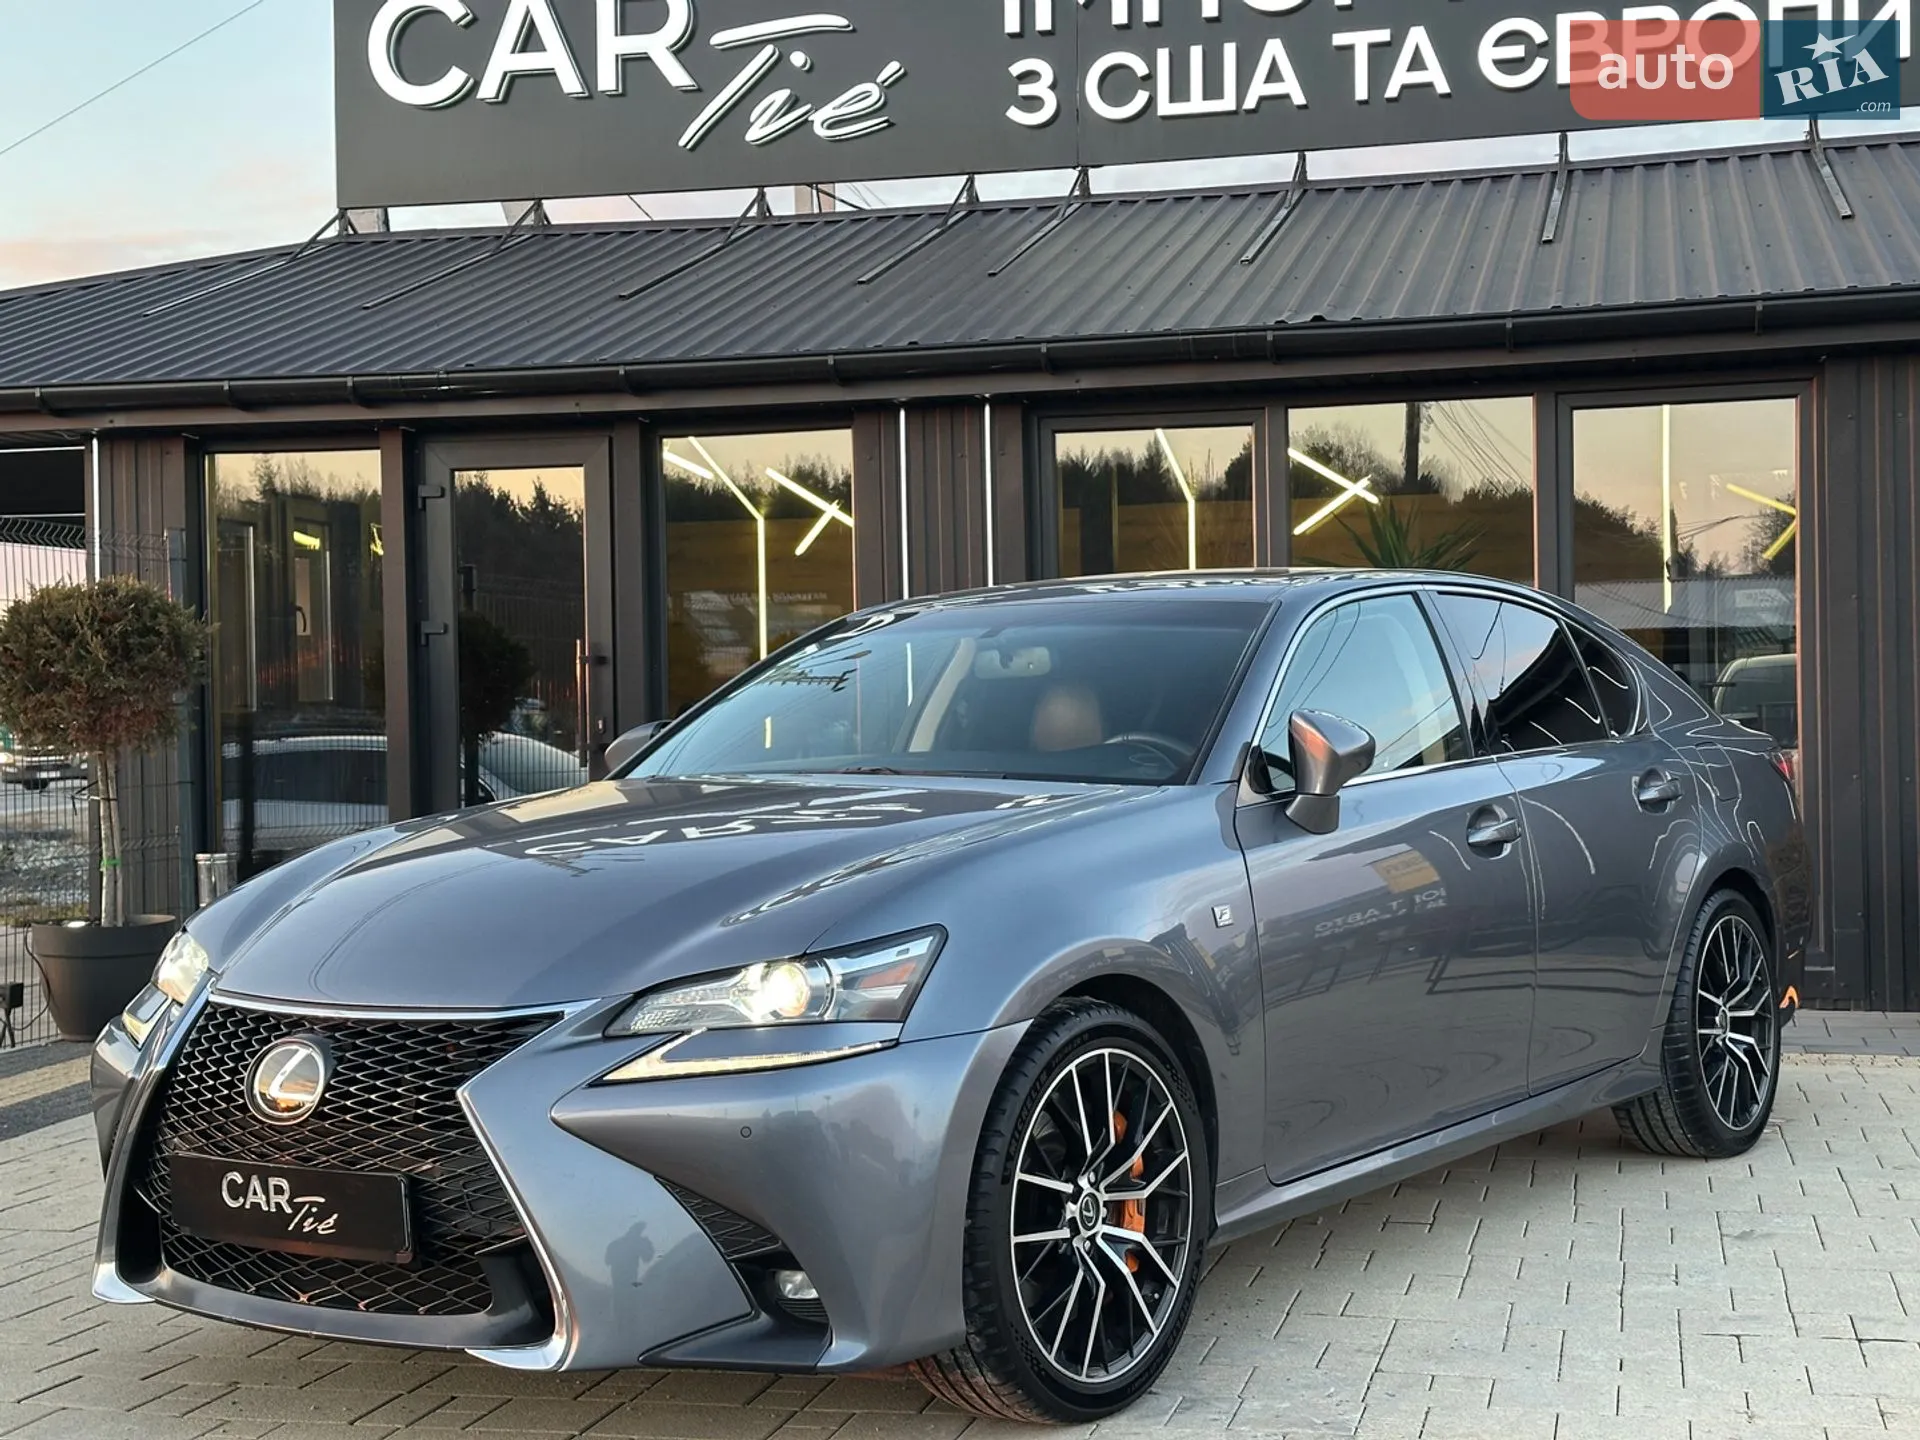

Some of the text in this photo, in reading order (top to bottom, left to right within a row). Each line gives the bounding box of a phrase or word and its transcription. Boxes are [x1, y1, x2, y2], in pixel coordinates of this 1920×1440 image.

[367, 0, 698, 108] CAR
[1084, 37, 1308, 121] США
[1331, 25, 1452, 102] ТА
[221, 1170, 294, 1214] CAR
